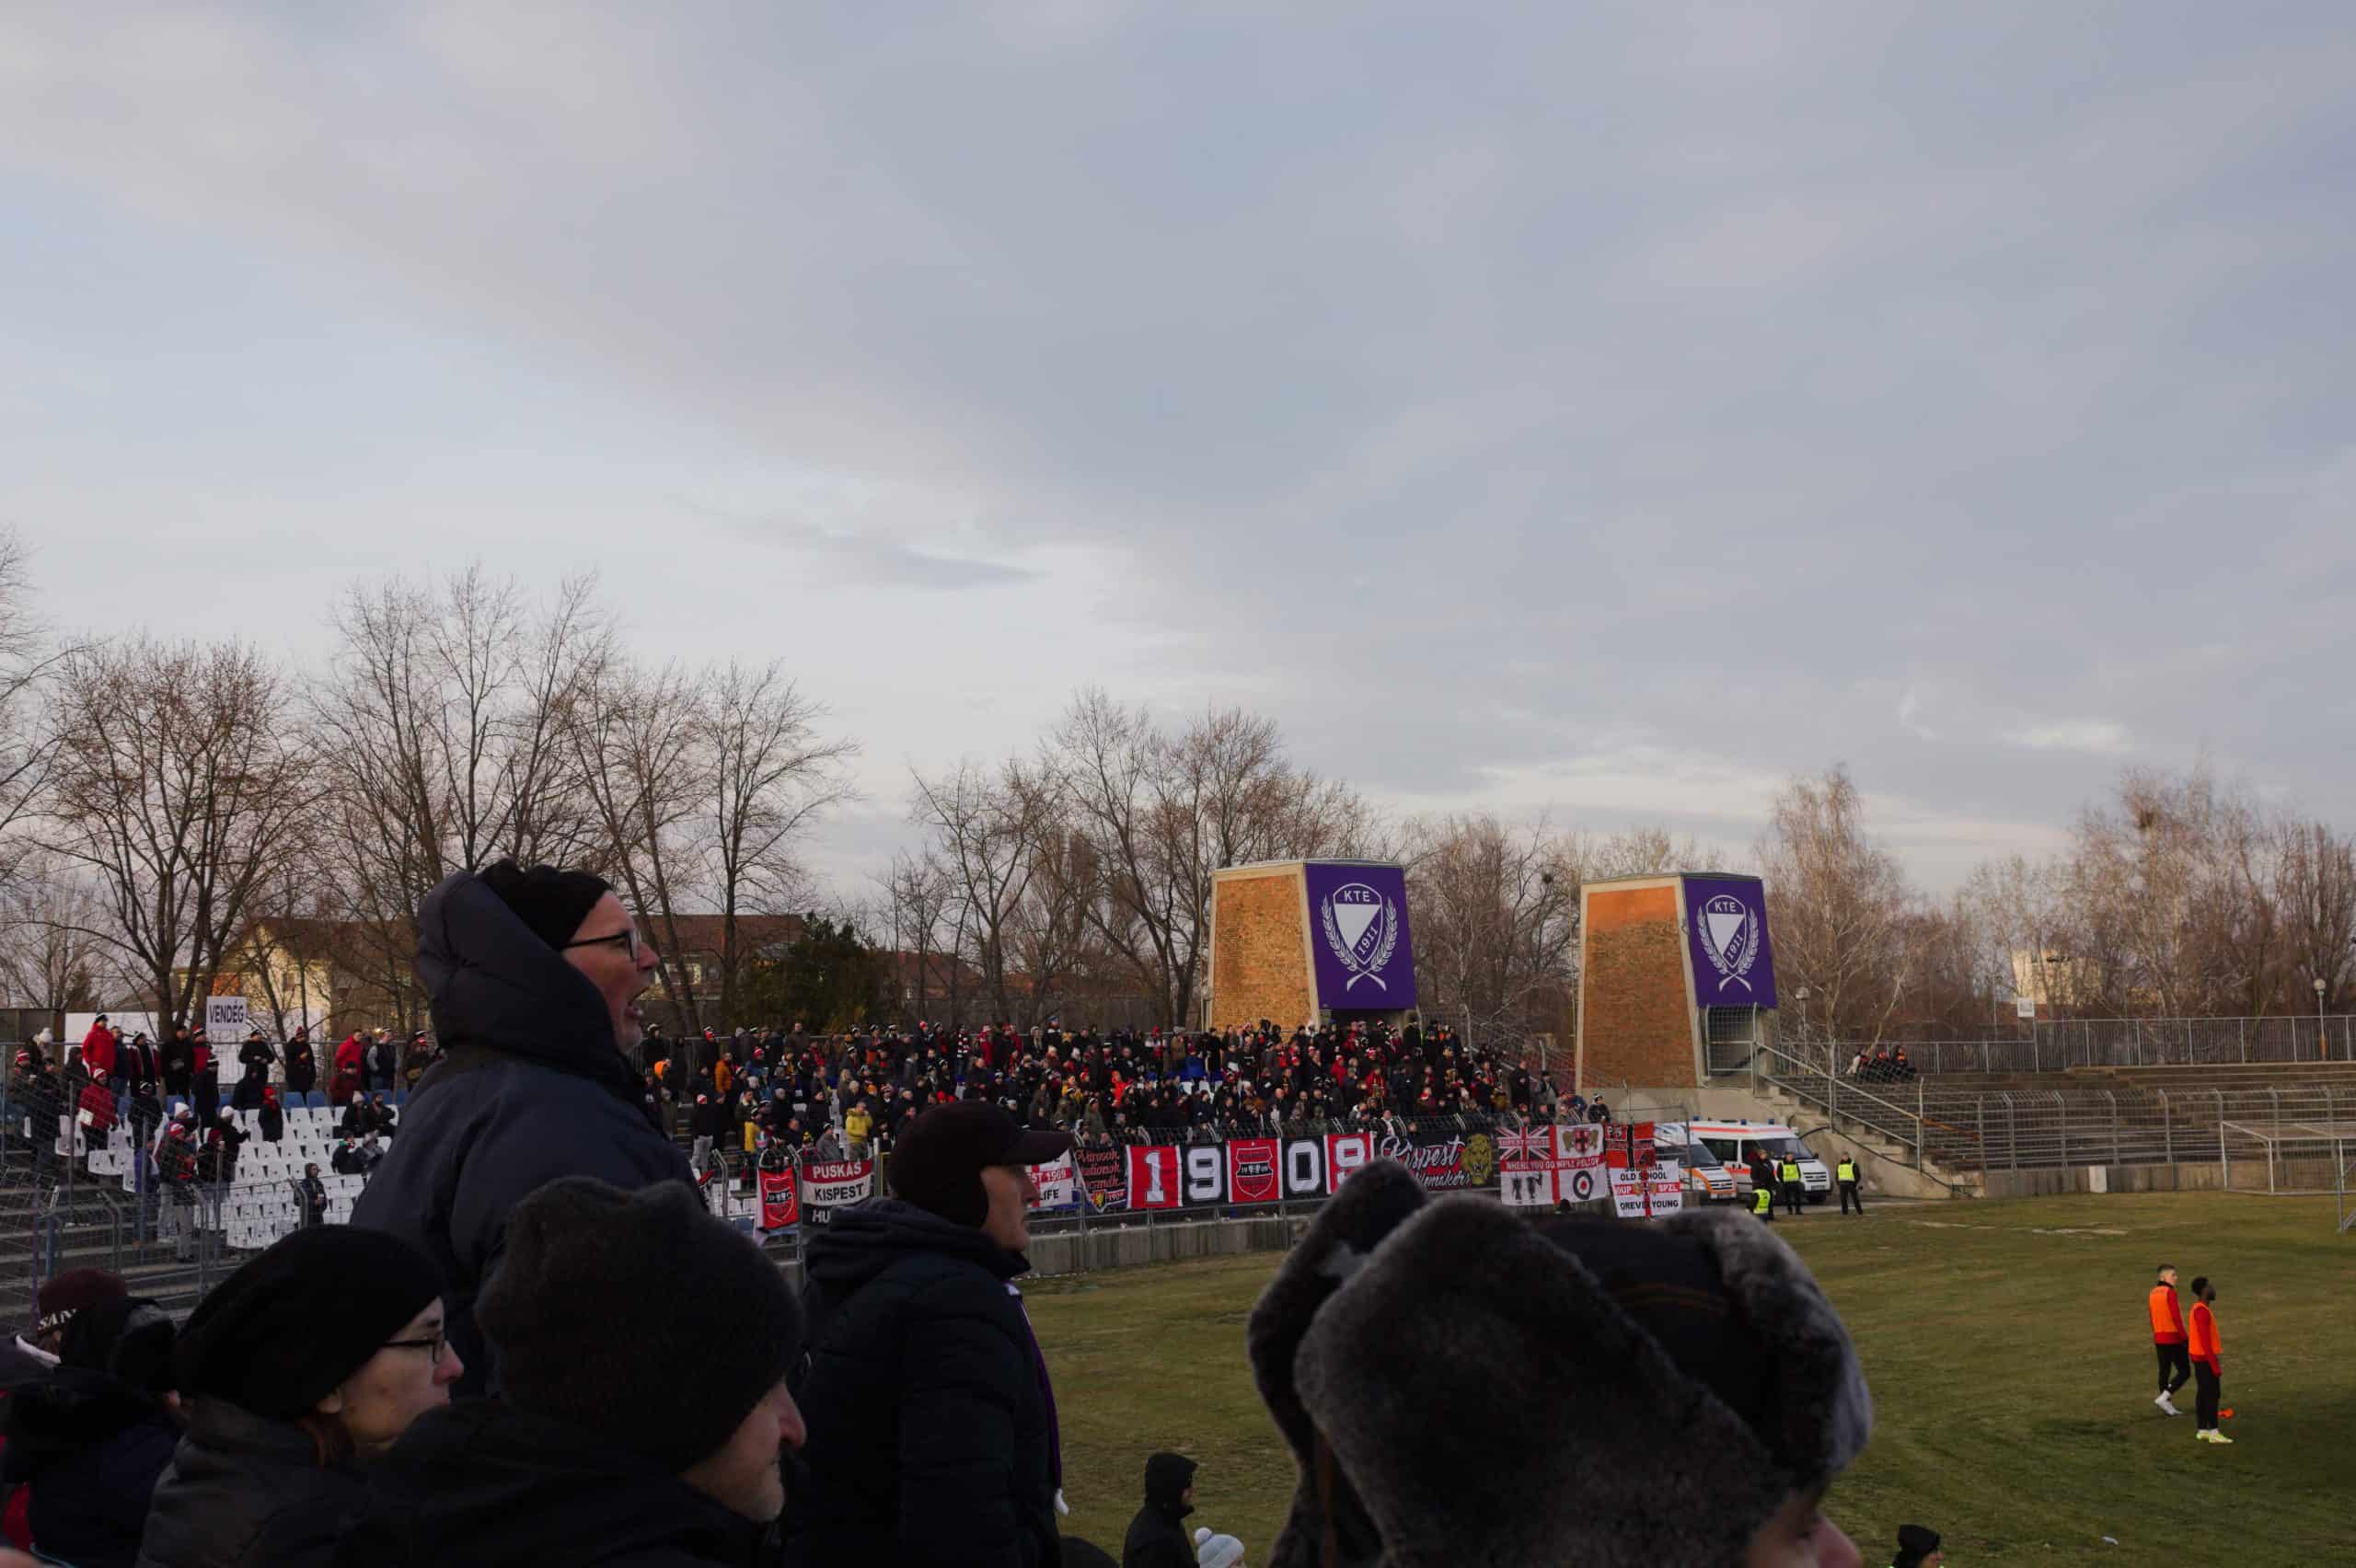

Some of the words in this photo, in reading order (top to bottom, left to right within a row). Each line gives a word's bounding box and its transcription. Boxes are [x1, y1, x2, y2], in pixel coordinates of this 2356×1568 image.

[1344, 890, 1370, 903] KTE
[1715, 902, 1737, 912] KTE
[1357, 926, 1379, 955] 1911
[1727, 934, 1744, 960] 1911
[209, 1000, 244, 1023] VENDÉG
[1620, 1173, 1636, 1182] OLD
[1639, 1171, 1668, 1181] SHOOL
[814, 1182, 864, 1201] KISPEST
[1652, 1199, 1679, 1208] YOUNG
